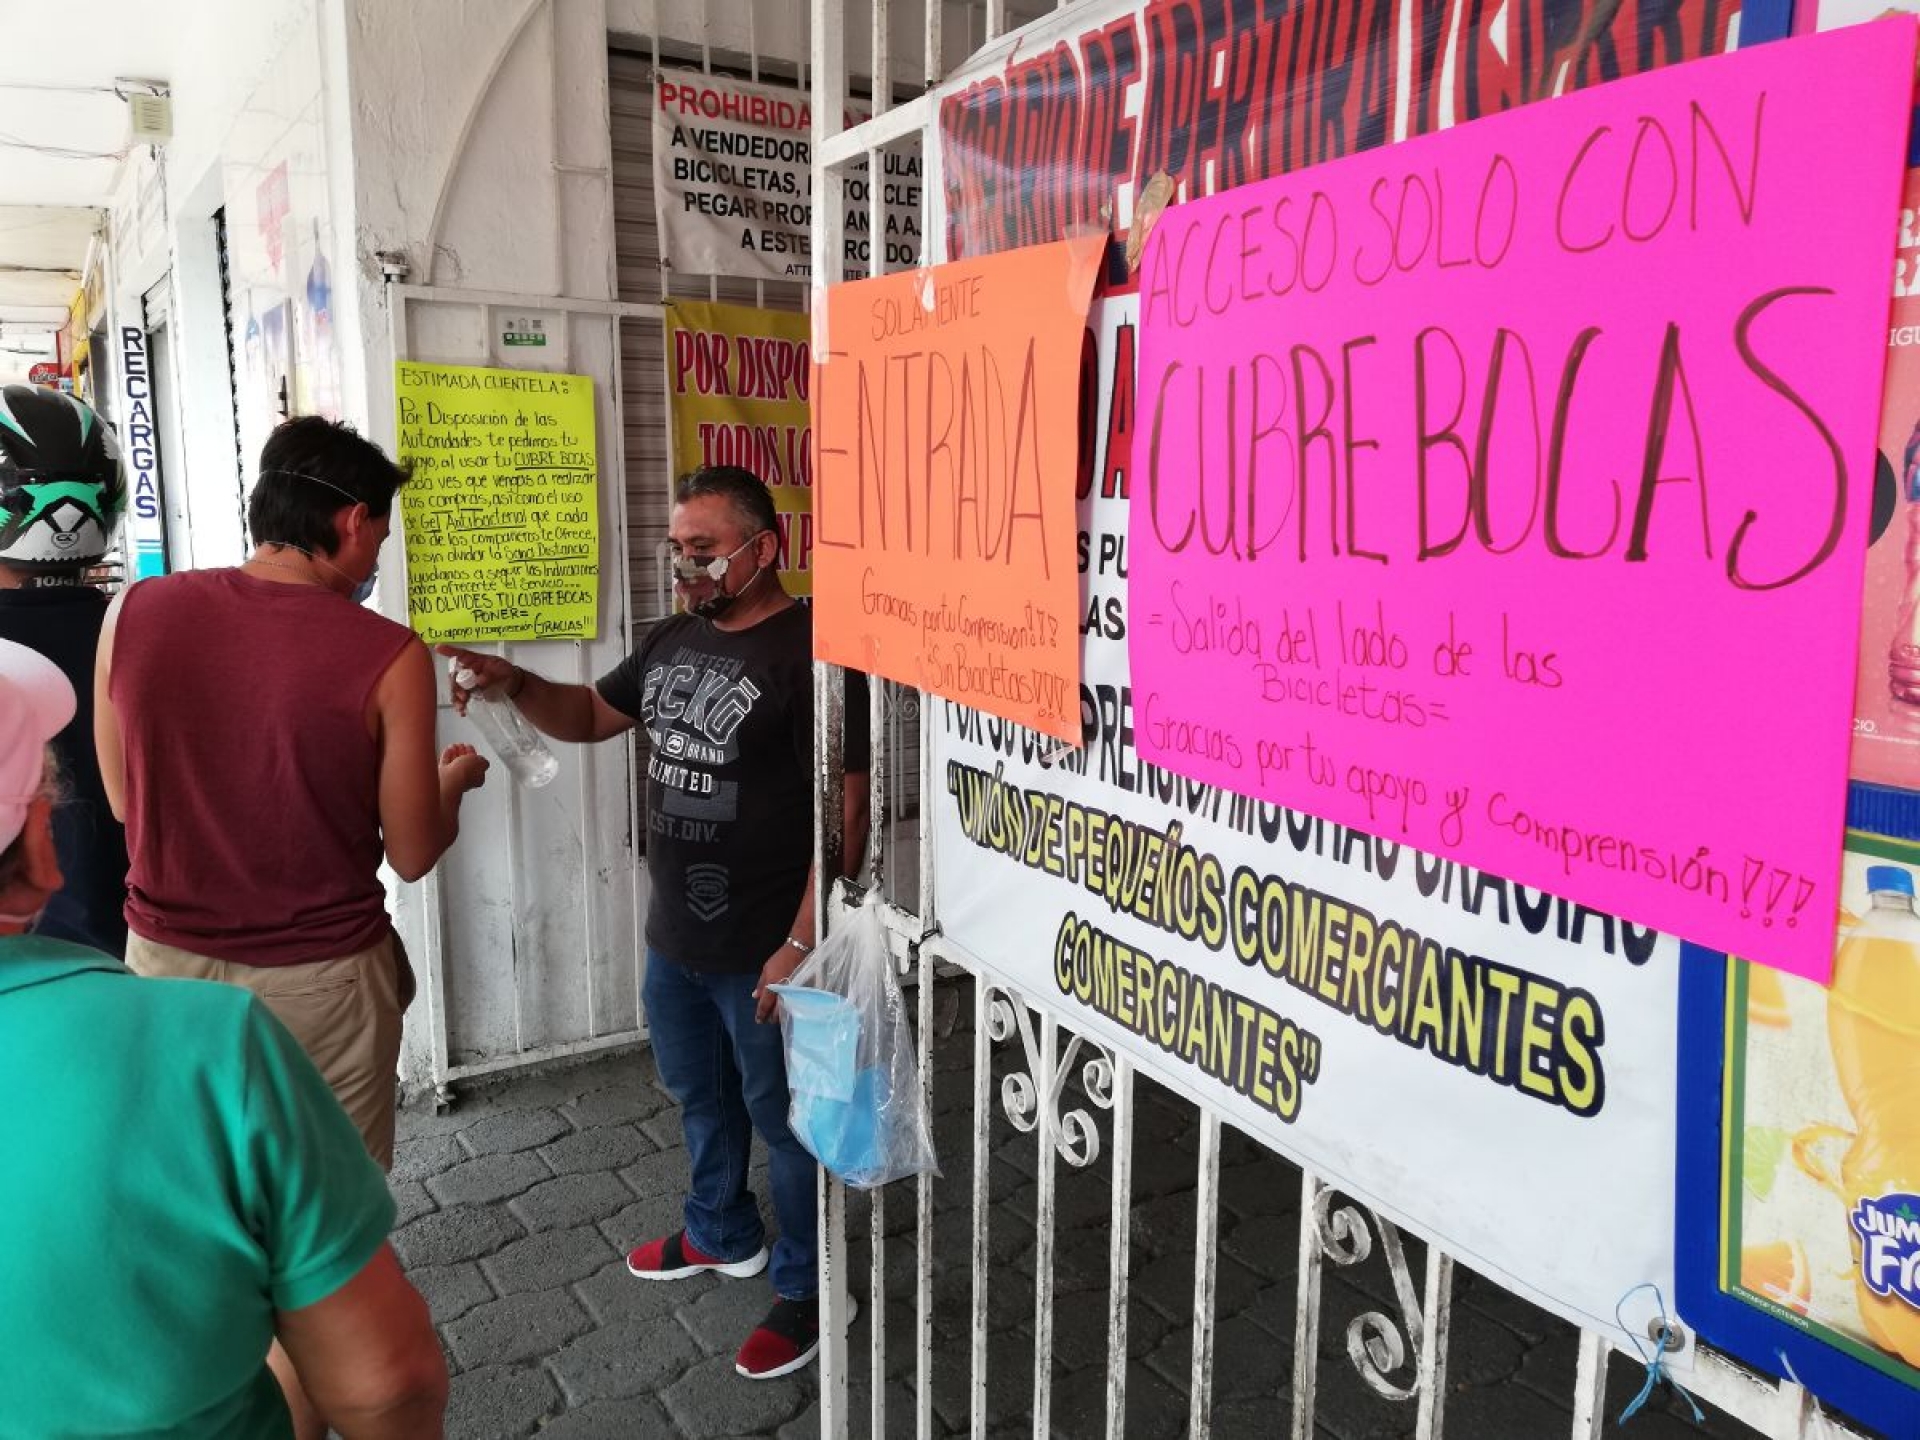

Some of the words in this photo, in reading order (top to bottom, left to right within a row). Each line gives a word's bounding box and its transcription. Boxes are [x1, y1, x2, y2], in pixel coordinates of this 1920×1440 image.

[659, 81, 812, 130] PROHIBIDA
[671, 125, 688, 147] A
[674, 158, 801, 198] BICICLETAS,
[684, 192, 759, 220] PEGAR
[1147, 189, 1339, 328] ACCESO
[1354, 154, 1518, 286] SOLO
[1556, 91, 1766, 253] CON
[741, 228, 756, 250] A
[401, 367, 481, 391] ESTIMADA
[674, 329, 731, 395] POR
[734, 335, 812, 401] DISPO
[121, 327, 158, 519] RECARGAS
[399, 396, 423, 425] Por
[514, 408, 529, 427] de
[534, 410, 558, 427] las
[487, 431, 505, 447] te
[560, 430, 579, 447] tu
[1148, 335, 1389, 565] CUBRE
[1415, 287, 1849, 591] BOCAS
[458, 454, 489, 468] usar
[493, 450, 512, 468] tu
[818, 336, 1050, 580] ENTRADA
[465, 475, 487, 494] que
[537, 473, 548, 486] a
[402, 492, 426, 511] tus
[556, 507, 588, 523] cada
[436, 592, 494, 614] OLVIDES
[495, 591, 515, 608] TU
[861, 566, 918, 627] Gracias
[1276, 608, 1320, 670] del
[1338, 598, 1409, 669] lado
[1433, 611, 1473, 676] de
[1502, 612, 1563, 688] las
[686, 742, 724, 765] BRAND
[1144, 691, 1243, 769] Gracias
[1256, 739, 1296, 787] por
[1300, 731, 1335, 788] tu
[1346, 762, 1427, 834] apoyo
[1439, 785, 1470, 847] y
[1023, 789, 1065, 878] DE
[1065, 797, 1227, 952] PEQUEÑOS
[1230, 872, 1605, 1118] COMERCIANTES
